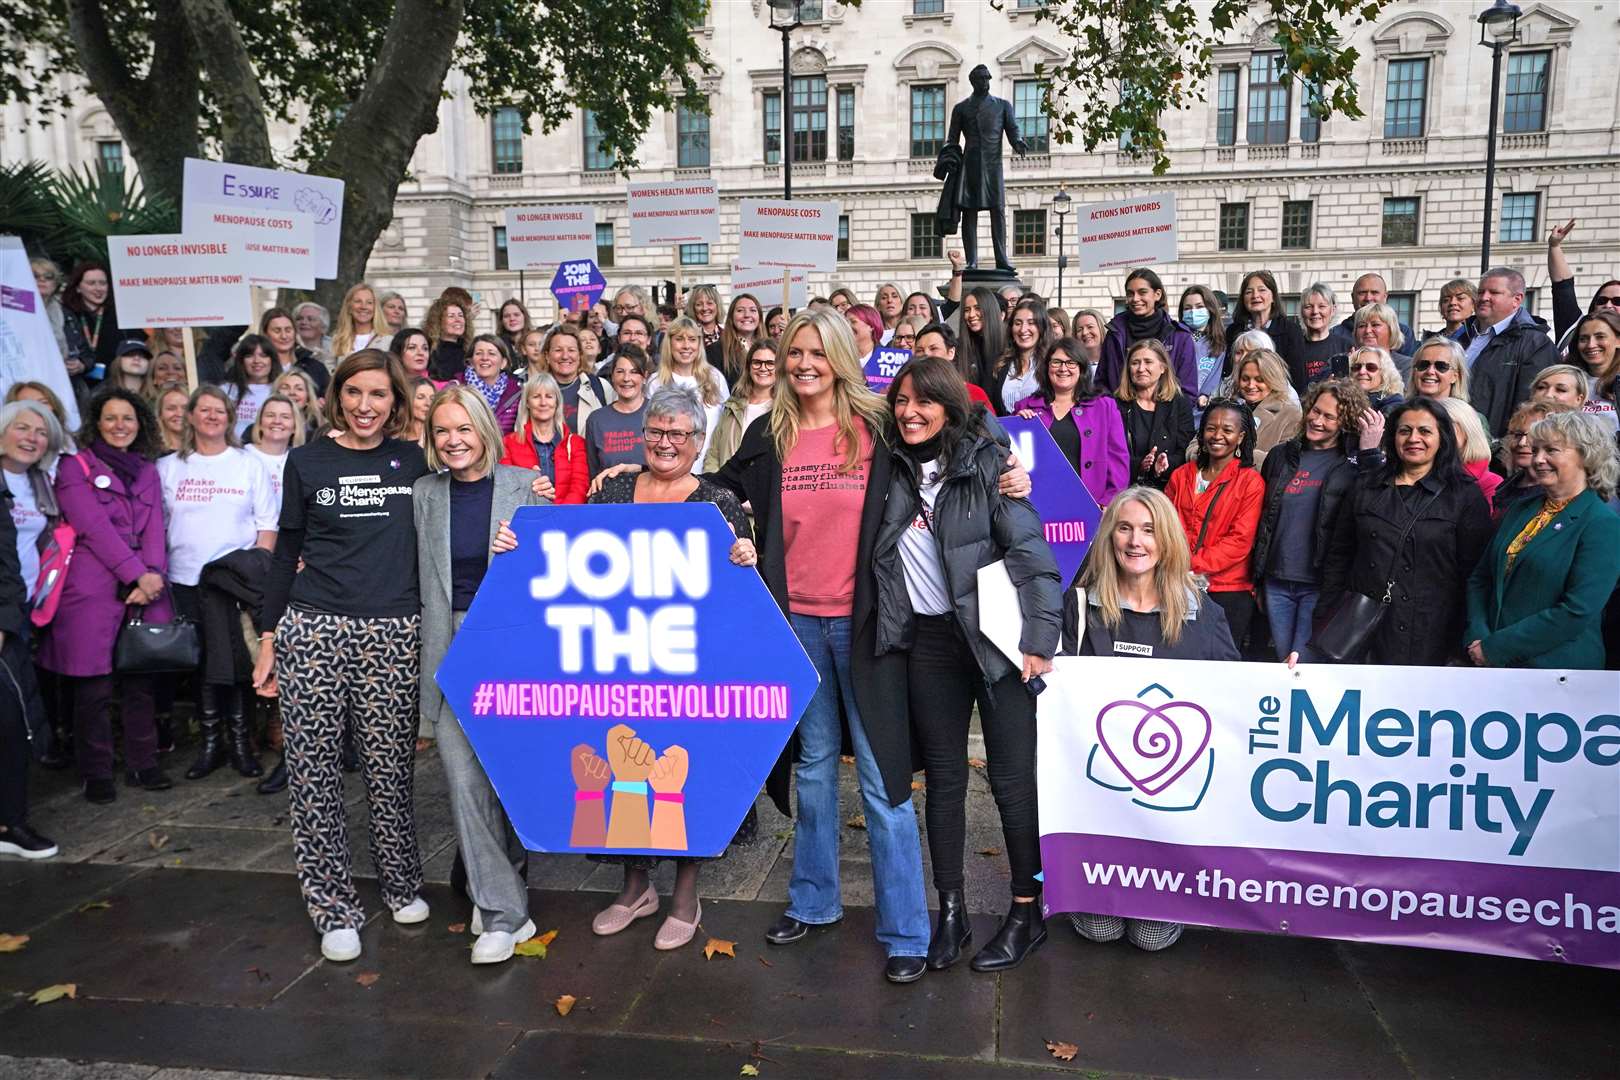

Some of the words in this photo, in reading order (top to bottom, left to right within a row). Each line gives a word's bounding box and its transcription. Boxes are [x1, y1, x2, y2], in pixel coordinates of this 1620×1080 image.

[631, 190, 659, 198] WOMENS
[660, 188, 684, 197] HEALTH
[685, 186, 714, 195] MATTERS
[517, 214, 526, 222] NO
[527, 213, 551, 221] LONGER
[552, 212, 583, 221] INVISIBLE
[648, 210, 678, 218] MENOPAUSE
[680, 208, 700, 216] MATTER
[757, 207, 799, 217] MENOPAUSE
[800, 208, 821, 218] COSTS
[1091, 207, 1118, 220] ACTIONS
[1120, 205, 1134, 215] NOT
[1135, 201, 1161, 213] WORDS
[213, 214, 266, 227] MENOPAUSE
[267, 219, 293, 230] COSTS
[743, 230, 759, 238] MAKE
[760, 231, 794, 239] MENOPAUSE
[794, 232, 817, 240] MATTER
[1082, 235, 1097, 243] MAKE
[1098, 229, 1131, 241] MENOPAUSE
[1132, 226, 1155, 236] MATTER
[1155, 223, 1172, 233] NOW!
[127, 246, 141, 257] NO
[143, 244, 179, 257] LONGER
[181, 243, 228, 255] INVISIBLE
[262, 244, 289, 254] MATTER
[563, 262, 591, 276] JOIN
[119, 278, 140, 287] MAKE
[142, 277, 187, 286] MENOPAUSE
[189, 275, 220, 285] MATTER
[565, 274, 590, 286] THE
[877, 351, 910, 365] JOIN
[878, 364, 902, 377] TH
[176, 486, 245, 496] Menopause
[345, 485, 413, 498] Menopause
[780, 482, 865, 492] otasmyflushes
[175, 494, 214, 502] Matter
[340, 495, 386, 507] Charity
[530, 529, 709, 600] JOIN
[545, 605, 698, 674] THE
[1119, 644, 1151, 653] SUPPORT
[472, 682, 788, 720] #MENOPAUSEREVOLUTION
[1249, 695, 1281, 755] The
[1287, 689, 1620, 782] Menopa
[1249, 758, 1555, 856] Charity
[1082, 860, 1620, 934] www.themenopausecha
